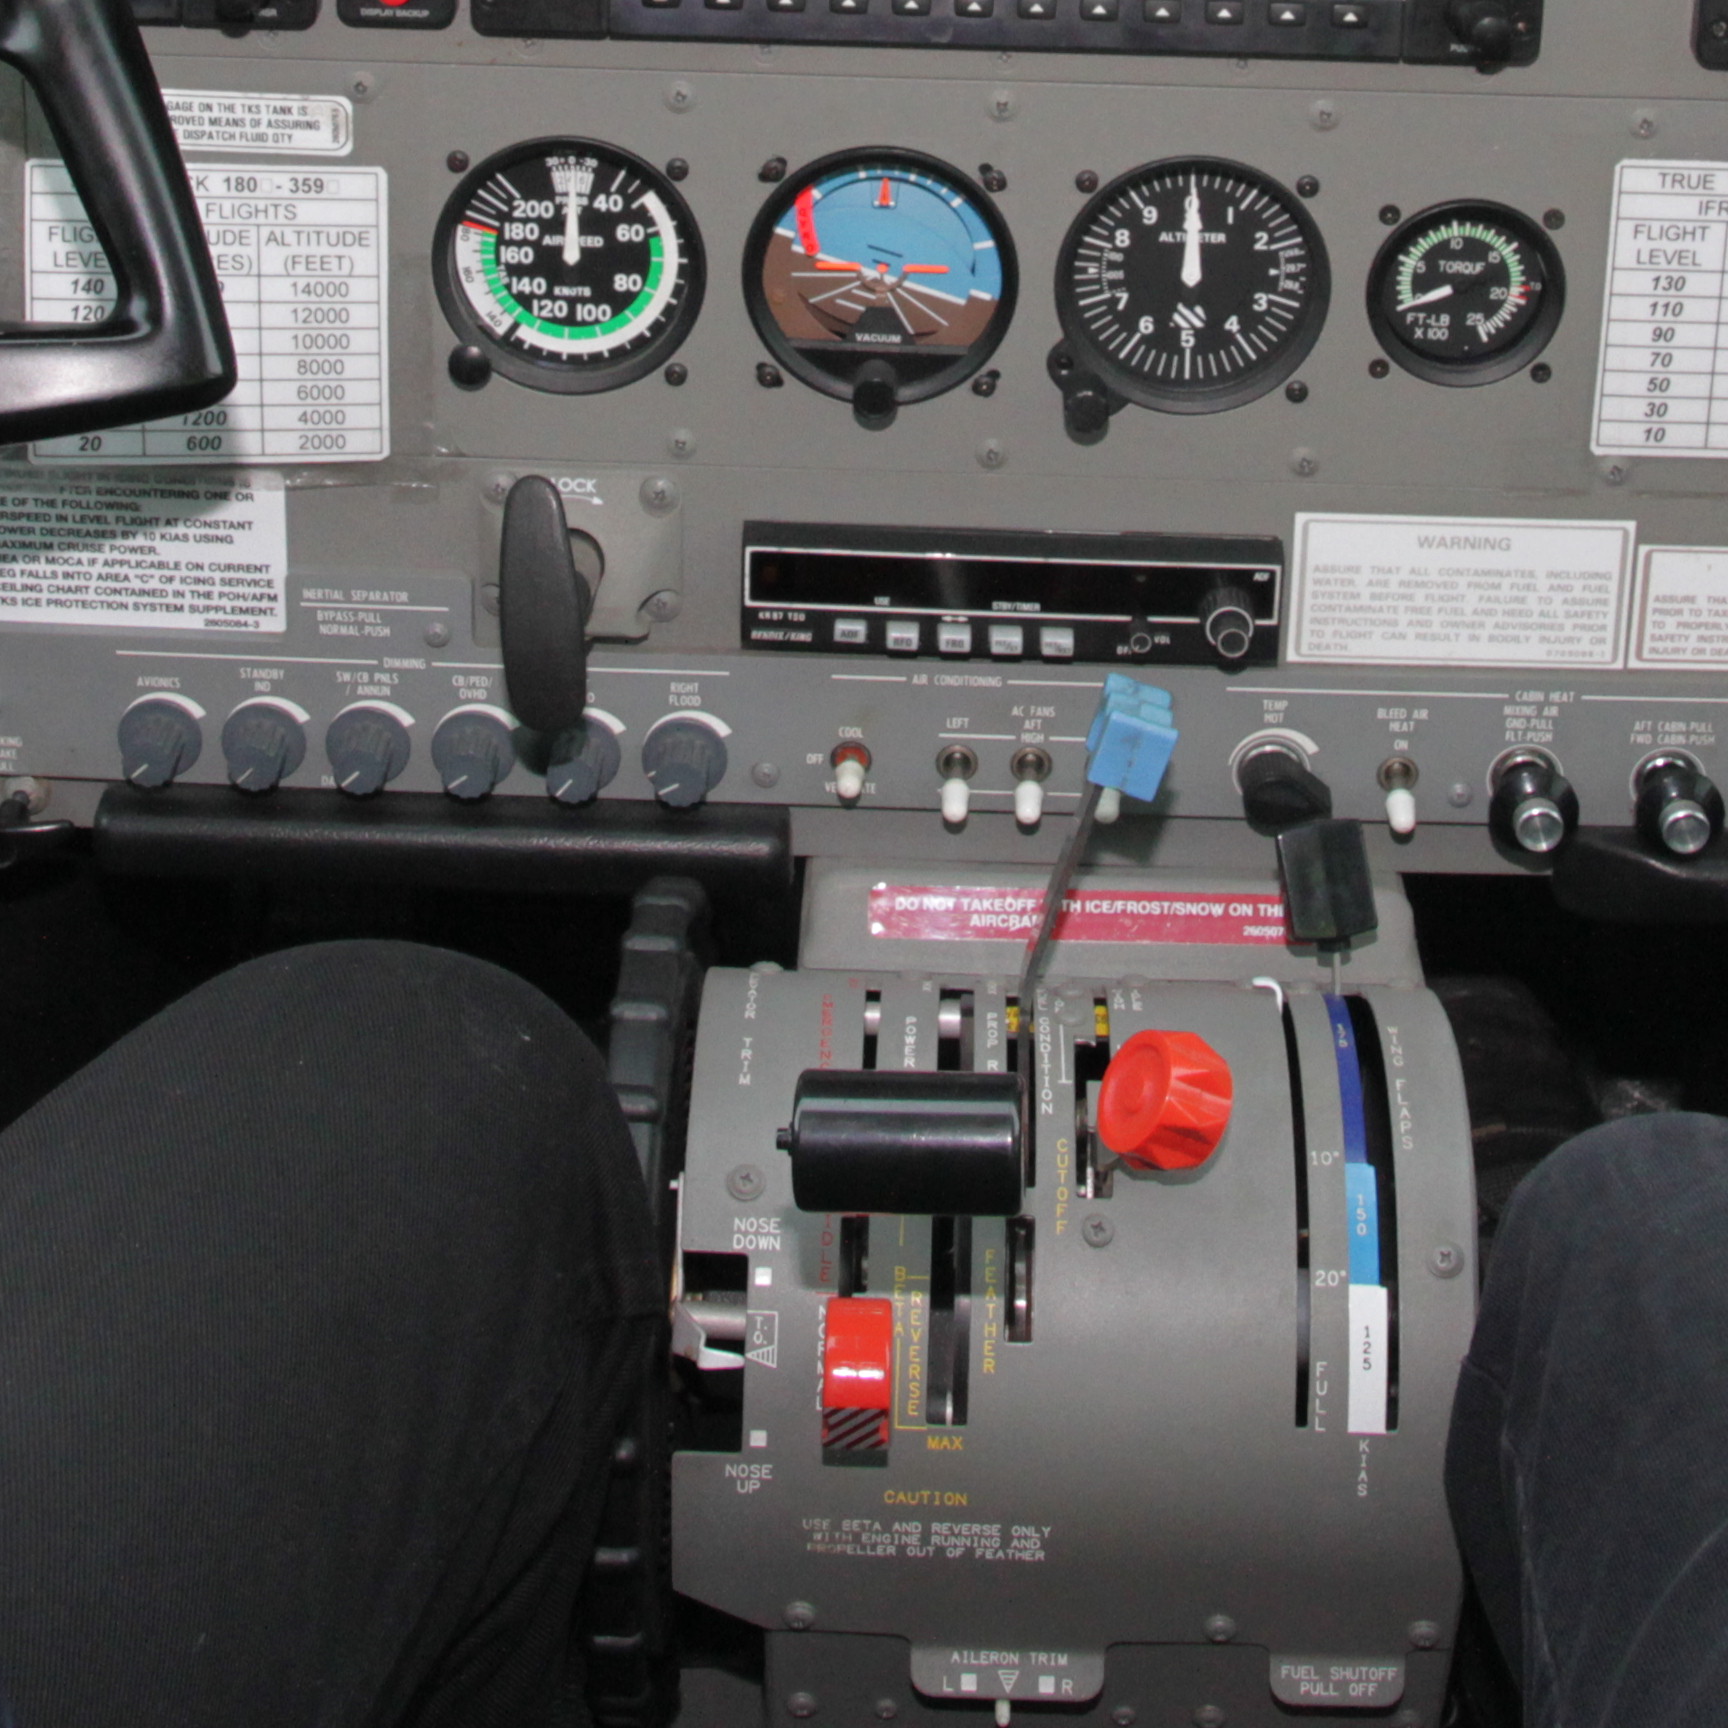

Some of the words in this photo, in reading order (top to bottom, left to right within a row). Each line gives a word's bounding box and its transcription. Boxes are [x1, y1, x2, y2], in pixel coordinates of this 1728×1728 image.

[199, 103, 213, 113] ON
[218, 103, 237, 113] THE
[241, 105, 261, 114] TKS
[266, 105, 293, 115] TANK
[298, 106, 307, 115] IS
[183, 130, 236, 141] DISPATCH
[239, 132, 268, 142] FLUID
[272, 133, 293, 143] QTY
[1659, 173, 1716, 191] TRUE
[512, 200, 554, 218] 200
[593, 194, 622, 212] 40
[205, 204, 297, 221] FLIGHTS
[1142, 207, 1158, 224] 9
[265, 230, 371, 247] ALTITUDE
[504, 223, 539, 240] 180
[616, 225, 644, 241] 60
[1115, 229, 1130, 248] 8
[1633, 225, 1710, 242] FLIGHT
[1254, 233, 1269, 249] 2
[500, 247, 534, 263] 160
[1636, 250, 1701, 267] LEVEL
[284, 255, 354, 274] (FEET)
[70, 279, 104, 295] 140
[289, 282, 350, 297] 14000
[511, 277, 546, 294] 140
[614, 274, 642, 291] 80
[1651, 276, 1686, 292] 130
[554, 287, 591, 297] KNOTS
[533, 300, 568, 317] 120
[1115, 292, 1129, 309] 7
[1253, 293, 1268, 310] 3
[71, 306, 105, 322] 120
[290, 308, 350, 324] 12000
[576, 304, 611, 322] 100
[1648, 301, 1683, 318] 110
[1139, 316, 1153, 334] 6
[1224, 315, 1239, 332] 4
[1407, 313, 1449, 326] FT-LB
[291, 334, 351, 350] 10000
[855, 333, 901, 343] VACUUM
[1180, 331, 1195, 348] 5
[1652, 327, 1675, 343] 90
[296, 359, 344, 376] 8000
[1649, 352, 1672, 368] 70
[297, 385, 345, 401] 6000
[1647, 377, 1670, 394] 50
[298, 410, 346, 426] 4000
[1644, 403, 1668, 419] 30
[79, 436, 101, 451] 20
[186, 436, 222, 451] 600
[298, 435, 346, 451] 2000
[1643, 428, 1665, 443] 10
[1417, 535, 1511, 551] WARNING
[22, 598, 42, 607] ICE
[46, 599, 129, 611] PROTECTION
[132, 602, 184, 613] SYSTEM
[188, 604, 277, 617] SUPPLEMENT.
[383, 658, 426, 669] DIMMING
[137, 676, 180, 688] AVIONICS
[913, 675, 930, 685] AIR
[935, 675, 1002, 687] CONDITIONING
[1515, 690, 1544, 703] CABIN
[1548, 691, 1574, 703] HEAT
[1012, 706, 1025, 717] AC
[1029, 707, 1055, 717] FANS
[947, 718, 968, 728] LEFT
[895, 897, 918, 911] DO
[924, 898, 956, 912] NOT
[961, 898, 1036, 912] TAKEOFF
[1085, 899, 1224, 916] ICE/FROST/SNOW
[1229, 903, 1252, 916] ON
[904, 1017, 916, 1068] POWER
[1388, 1025, 1405, 1067] WING
[739, 1038, 752, 1085] TRIM
[1041, 1018, 1052, 1114] CONDITION
[1394, 1079, 1414, 1150] FLAPS
[1056, 1140, 1068, 1234] CUTOFF
[734, 1218, 780, 1232] NOSE
[733, 1235, 780, 1250] DOWN
[983, 1250, 996, 1373] FEATHER
[908, 1292, 920, 1415] REVERSE
[1316, 1362, 1326, 1431] FULL
[927, 1437, 963, 1450] MAX
[725, 1464, 772, 1478] NOSE
[1357, 1440, 1369, 1497] KIAS
[737, 1481, 760, 1493] UP
[884, 1491, 968, 1505] CAUTION
[893, 1523, 921, 1533] AND
[931, 1524, 1001, 1536] REVERSE
[1012, 1525, 1051, 1537] ONLY
[976, 1548, 1044, 1561] FEATHER
[950, 1651, 1019, 1667] AILERON
[1028, 1651, 1068, 1667] TRIM
[1280, 1667, 1323, 1680] FUEL
[1329, 1667, 1396, 1682] SHUTOFF
[1300, 1682, 1341, 1696] PULL
[1347, 1682, 1376, 1697] OFF
